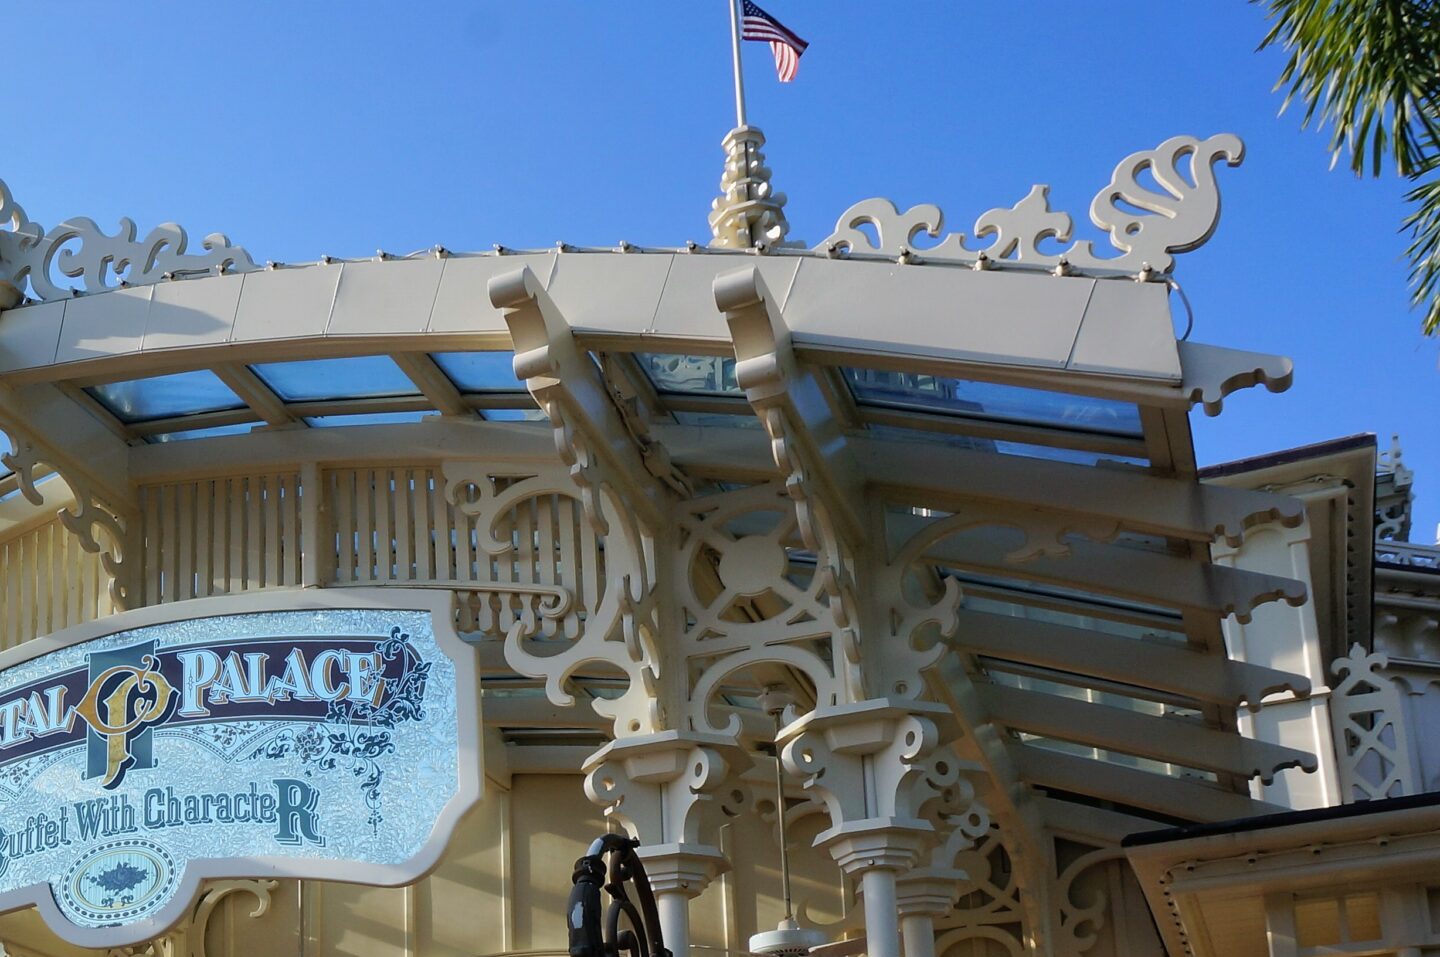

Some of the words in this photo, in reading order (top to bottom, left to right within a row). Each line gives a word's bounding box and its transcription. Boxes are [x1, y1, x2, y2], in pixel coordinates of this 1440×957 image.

[177, 648, 382, 716] PALACE
[74, 796, 138, 842] With
[143, 779, 326, 848] CharacteR
